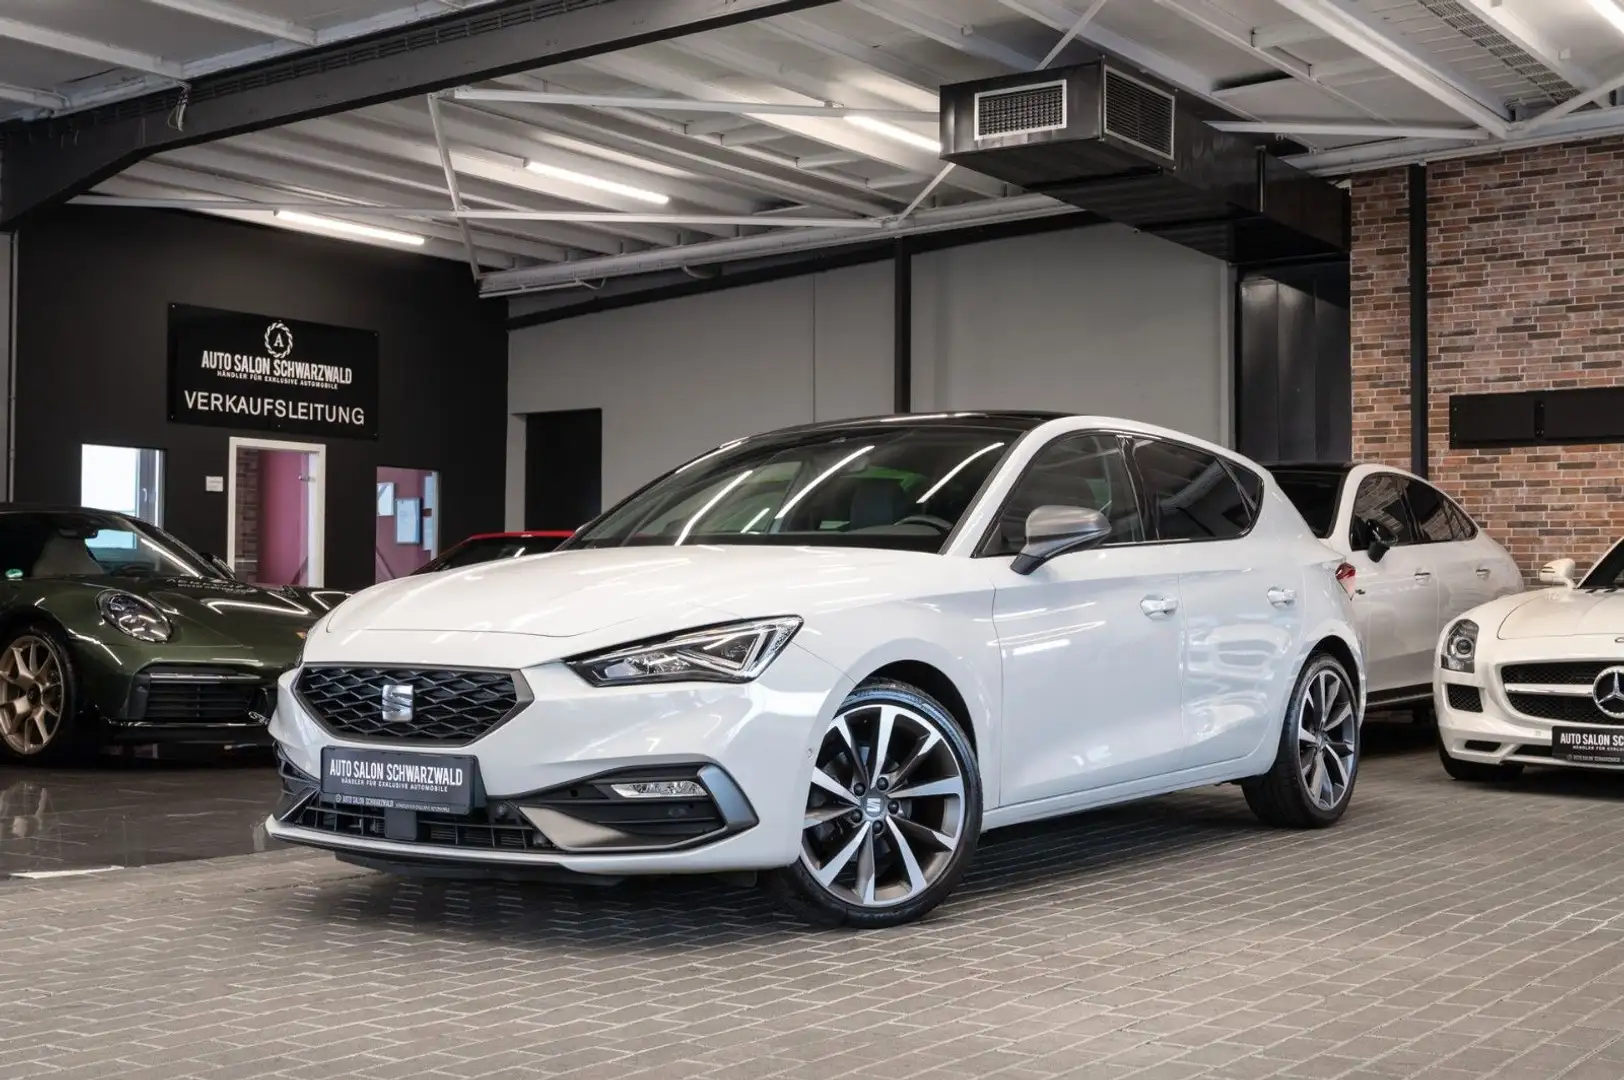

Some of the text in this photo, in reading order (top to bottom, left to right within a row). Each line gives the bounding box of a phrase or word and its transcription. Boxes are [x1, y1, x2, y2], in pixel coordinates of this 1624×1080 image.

[273, 333, 284, 347] A
[201, 350, 352, 384] AUTO SALON SCHWARZWALD
[217, 370, 338, 389] HÄNDLER FÜR EXKLUSIVE AUTOMOBILE
[184, 389, 364, 425] VERKAUFSLEITUNG
[1560, 733, 1581, 744] AUTO
[1582, 734, 1610, 745] SALON
[329, 760, 462, 786] AUTO SALON SCHWARZWALD
[366, 779, 377, 787] FÜR
[378, 781, 408, 789] EXKLUSIVE
[409, 784, 448, 793] AUTOMOBILE
